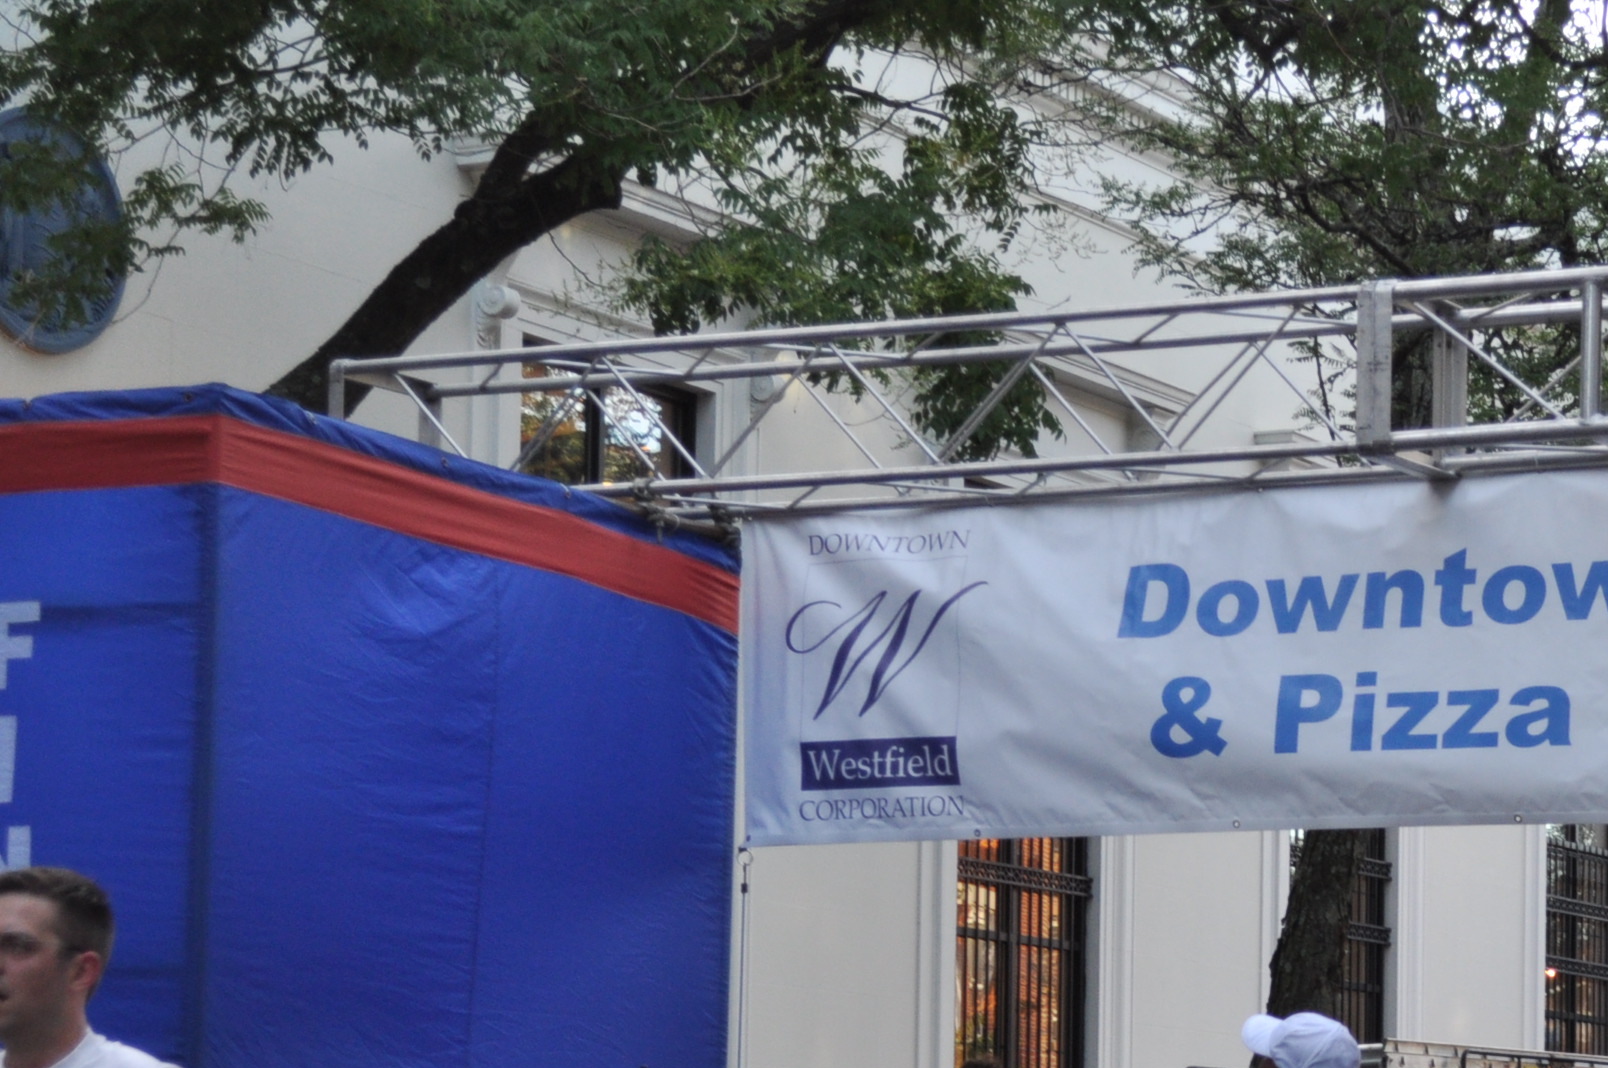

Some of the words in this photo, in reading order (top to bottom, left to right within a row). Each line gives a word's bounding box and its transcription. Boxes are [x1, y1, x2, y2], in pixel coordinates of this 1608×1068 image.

[808, 530, 970, 556] DOWNTOWN
[1150, 675, 1228, 758] &
[1274, 671, 1571, 754] Pizza
[808, 745, 954, 782] Westfield
[799, 796, 964, 822] CORPORATION
